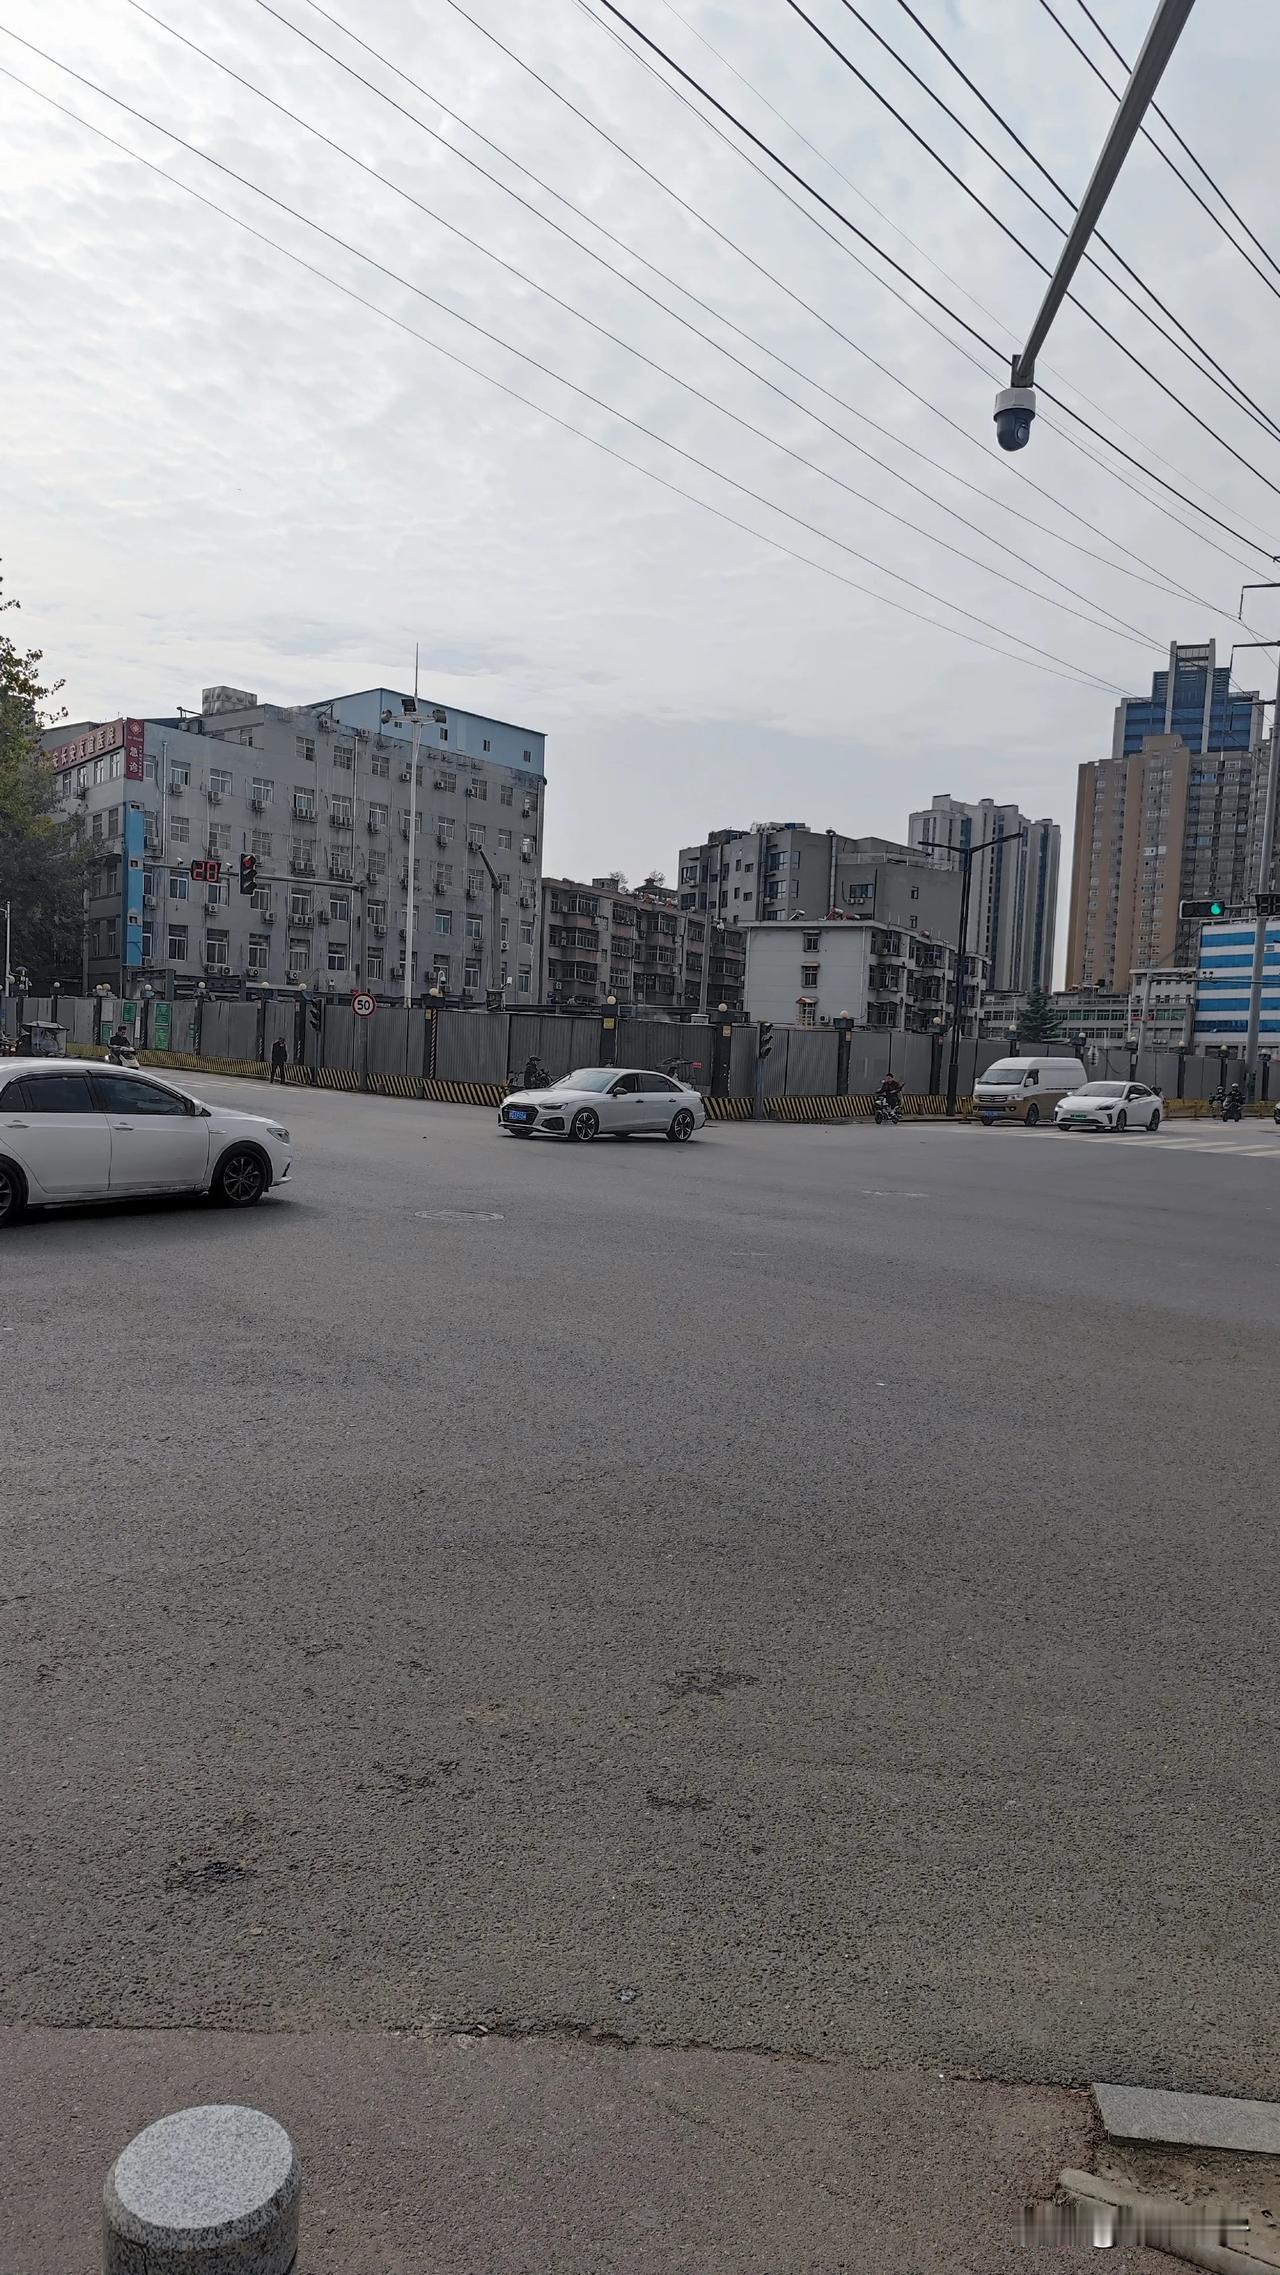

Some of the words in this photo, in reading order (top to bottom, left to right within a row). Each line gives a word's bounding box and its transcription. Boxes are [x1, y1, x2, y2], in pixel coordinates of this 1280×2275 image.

[129, 746, 139, 773] 急诊
[194, 861, 219, 882] 20
[357, 1000, 370, 1010] 50
